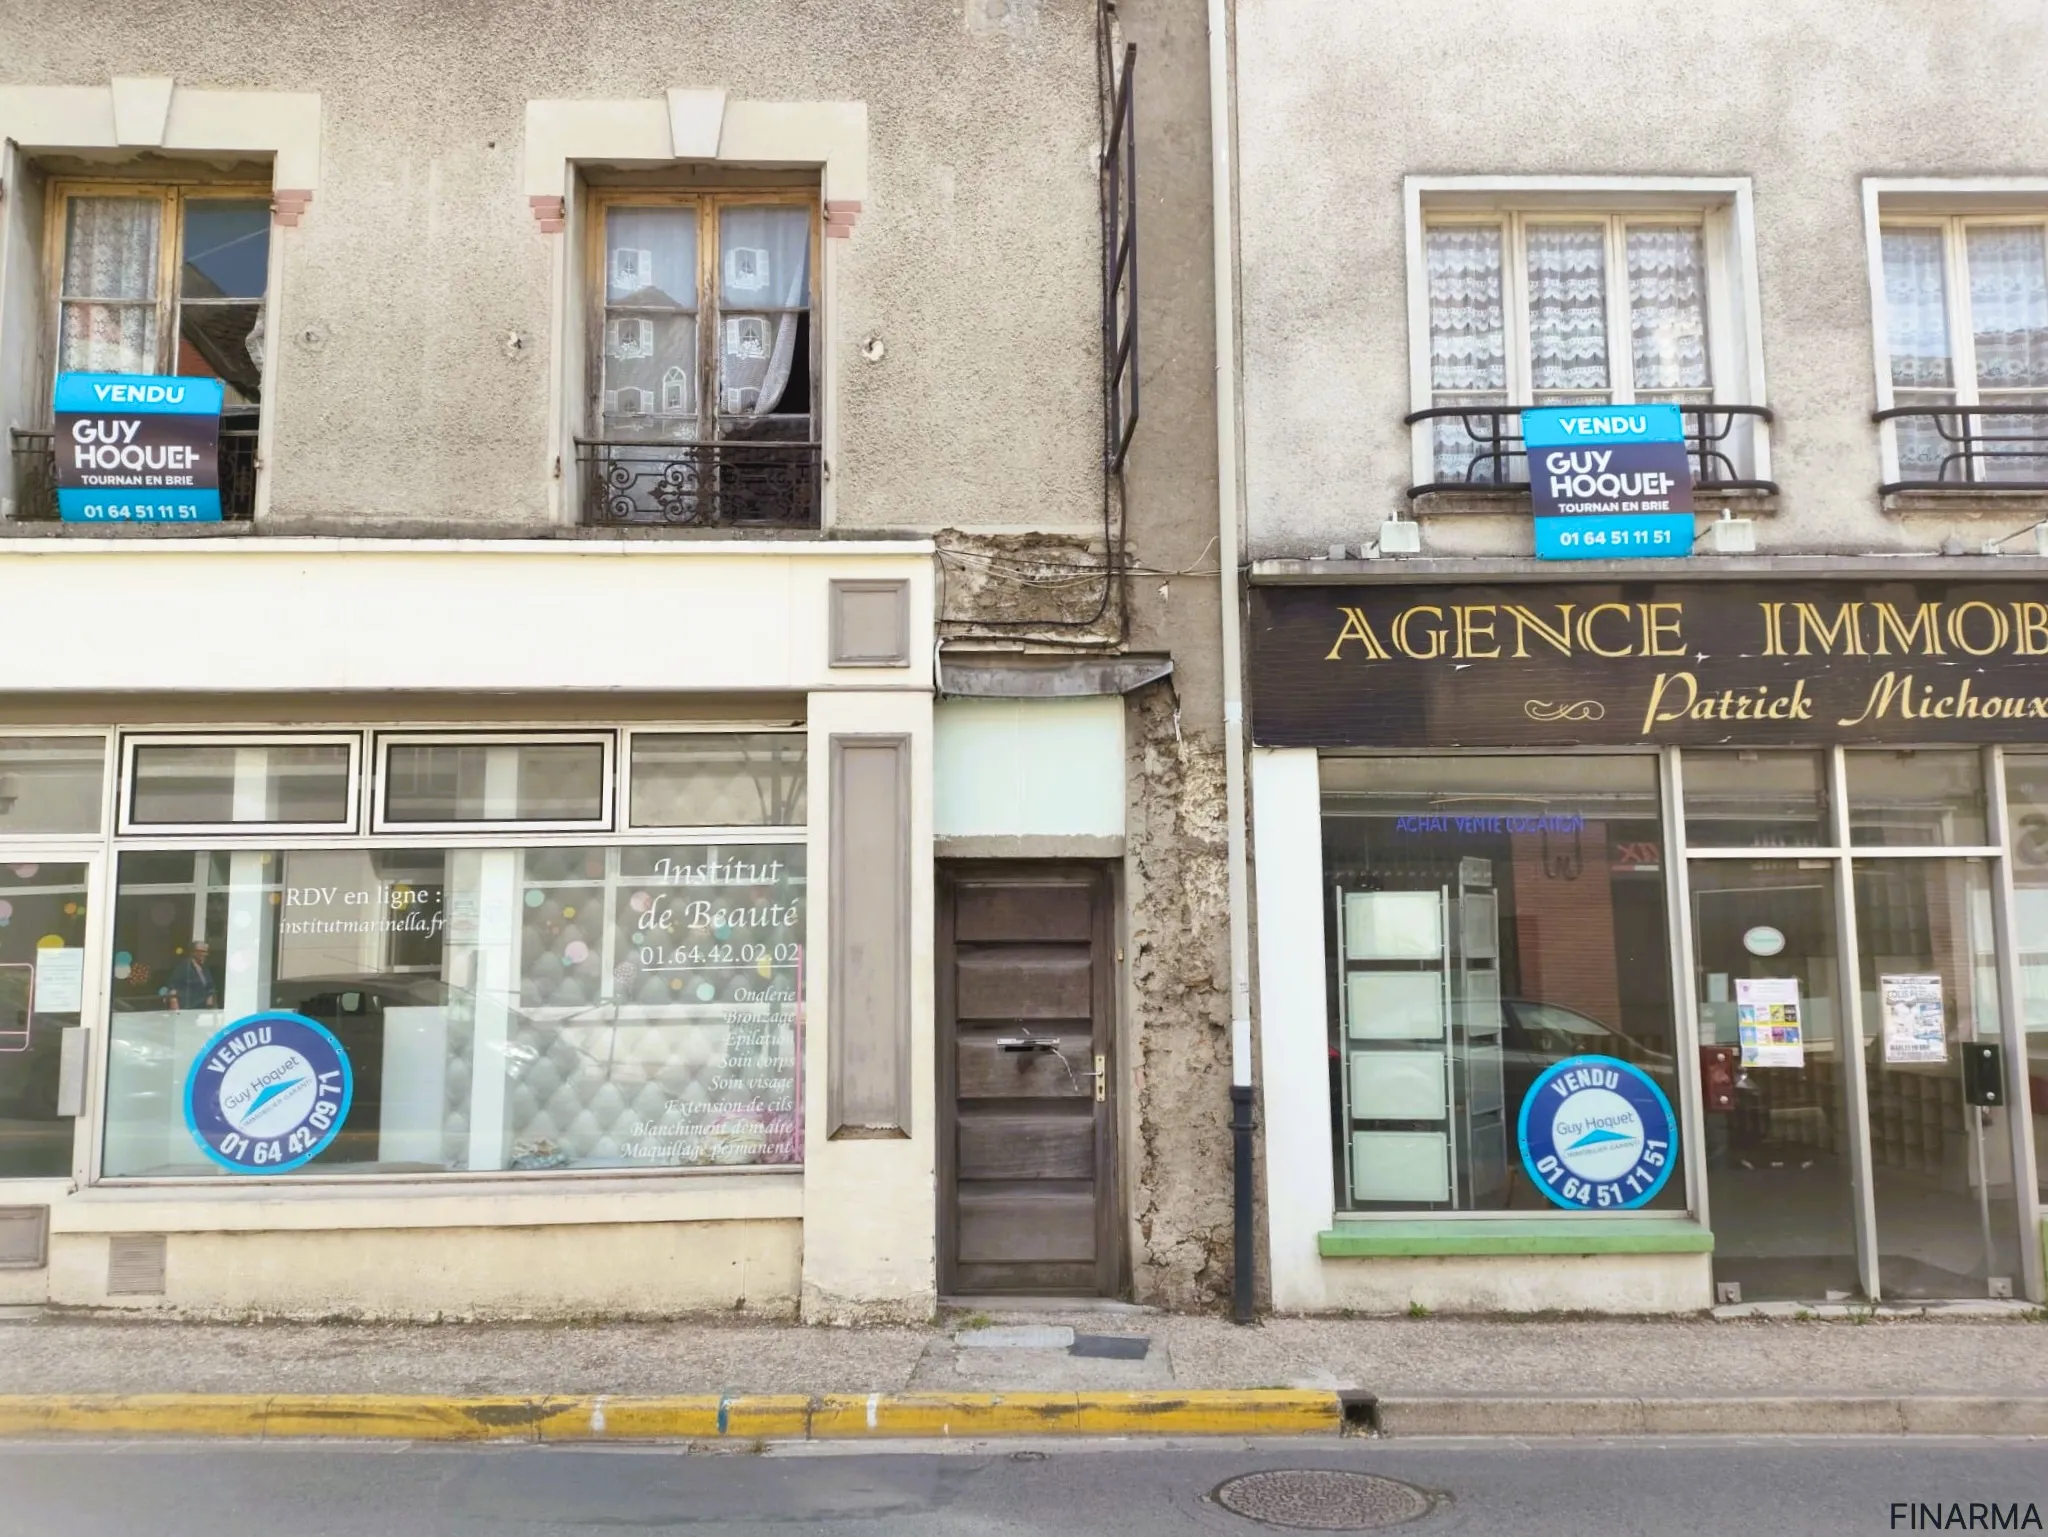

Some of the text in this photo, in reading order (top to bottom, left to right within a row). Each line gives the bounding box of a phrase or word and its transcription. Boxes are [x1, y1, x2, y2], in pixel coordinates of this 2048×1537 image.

[93, 384, 185, 404] VENDU
[72, 419, 142, 444] GUY
[1559, 416, 1647, 435] VENDU
[1546, 450, 1613, 474] GUY
[81, 475, 193, 486] TOURNAN EN BRIE
[84, 505, 197, 518] 01 64 51 11 51
[1558, 501, 1670, 513] TOURNAN EN BRIE
[1560, 530, 1671, 546] 01 64 51 11 51
[1325, 601, 2048, 660] AGENCE IMMOB
[1641, 671, 2048, 735] Patrick Michoux
[1396, 816, 1449, 833] ACHAT
[1455, 816, 1502, 834] VENTE
[654, 856, 785, 884] Institut
[286, 886, 338, 906] RDV
[344, 891, 369, 904] en
[378, 885, 428, 909] ligne
[638, 894, 800, 930] de Beauté
[279, 911, 447, 939] institutmarinella.fr
[640, 943, 800, 965] 01.64.42.02.02
[734, 985, 796, 1003] Onglerie
[724, 1009, 795, 1027] Bronzage
[207, 1027, 272, 1073] VENDU
[719, 1051, 795, 1073] Soin corps
[224, 1056, 300, 1109] Guy Hoquet
[708, 1075, 793, 1093] Soin visage
[1551, 1068, 1619, 1097] VENDU
[220, 1070, 341, 1164] 01 64 42 09 71
[665, 1096, 792, 1116] Extension de cils
[630, 1118, 793, 1136] Blanchiment dentaire
[1556, 1112, 1635, 1136] Guy Hoquet
[621, 1140, 791, 1160] Maquillage permanent
[1537, 1140, 1668, 1207] 01 64 51 11 51
